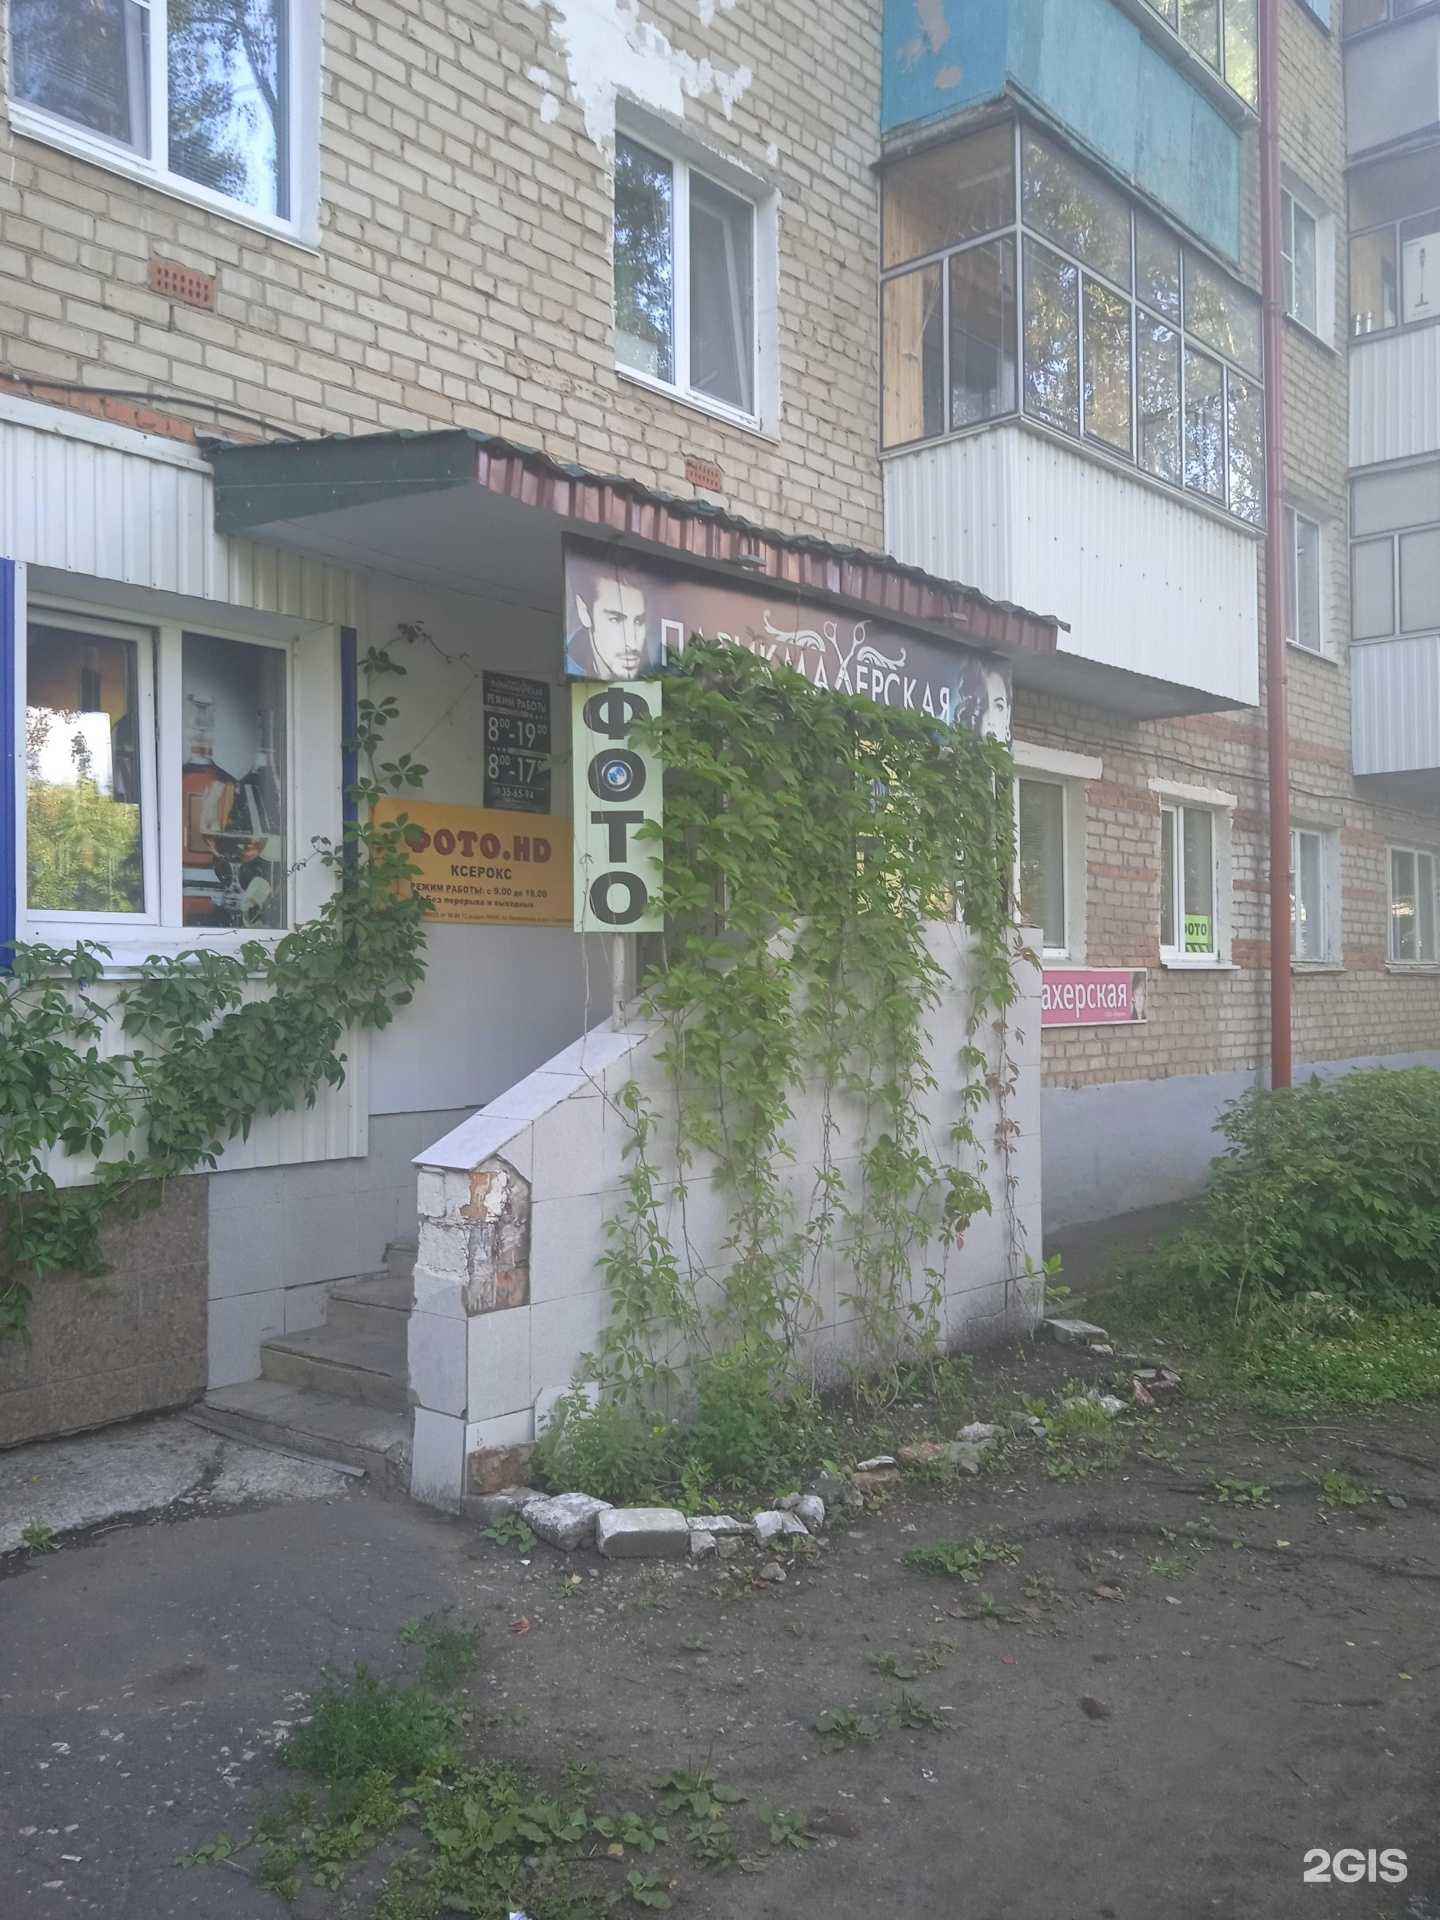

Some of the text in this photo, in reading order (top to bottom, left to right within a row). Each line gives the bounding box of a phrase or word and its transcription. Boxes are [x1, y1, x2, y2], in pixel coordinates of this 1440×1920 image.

[517, 697, 547, 713] РАБОТЫ
[583, 687, 652, 925] ФОТО
[451, 864, 512, 880] КСЕРОКС
[410, 882, 444, 893] РЕЖИМ
